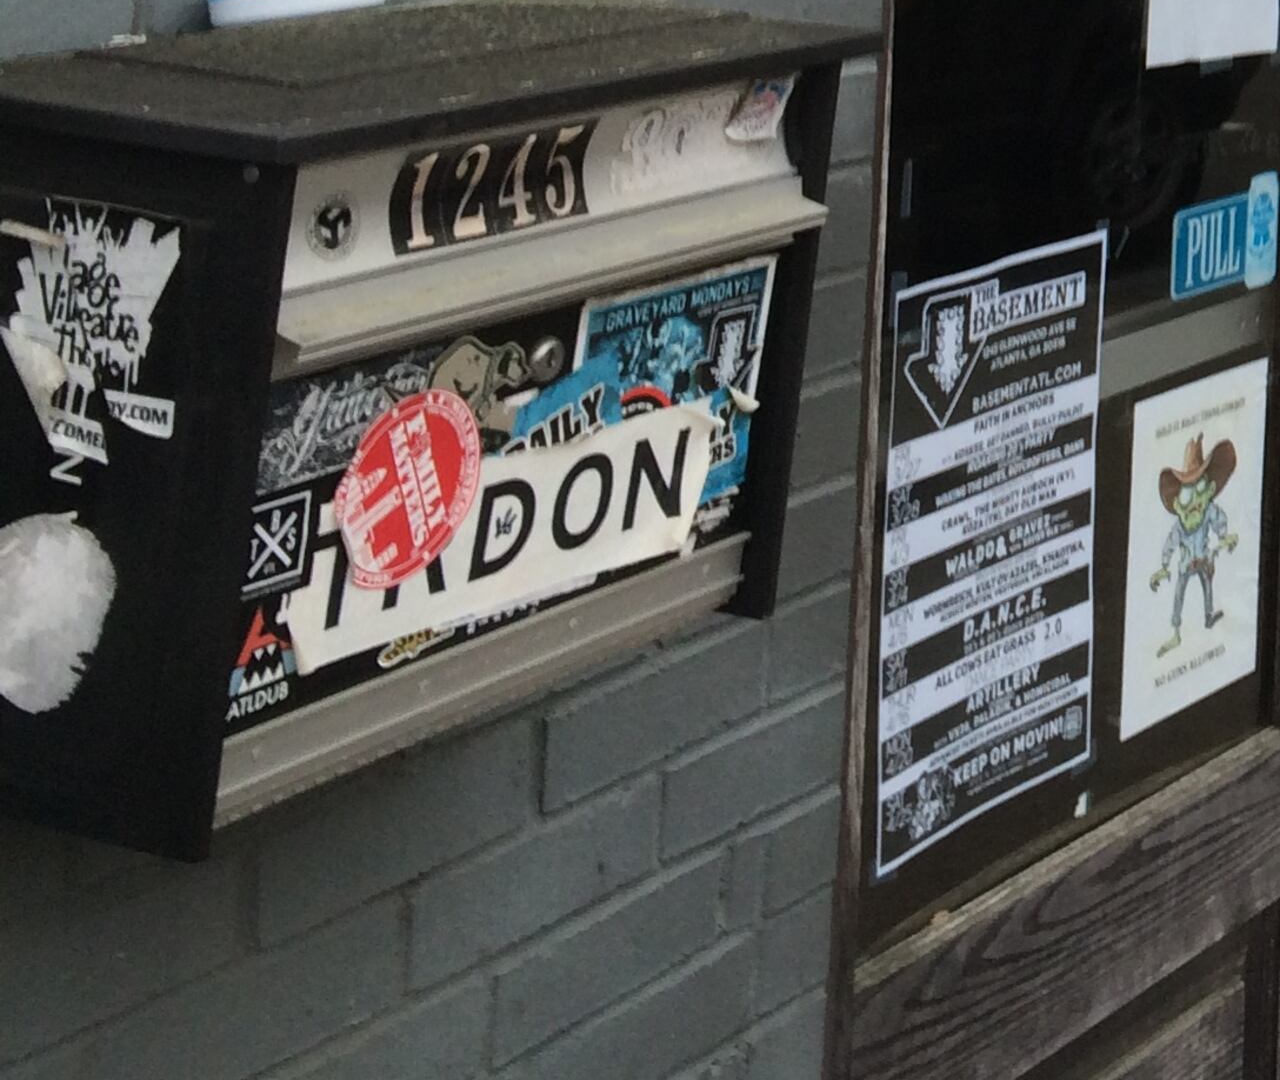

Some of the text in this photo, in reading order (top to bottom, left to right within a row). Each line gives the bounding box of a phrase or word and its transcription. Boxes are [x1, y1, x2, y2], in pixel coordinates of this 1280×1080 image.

[406, 125, 584, 250] 1245
[1185, 206, 1240, 289] PULL
[606, 293, 687, 333] GRAVEYARD
[690, 276, 750, 310] MONDAYS
[973, 276, 1083, 337] BASEMENT
[974, 285, 997, 304] THE
[972, 361, 1082, 413] BASEMENTATL.COM
[388, 421, 430, 548] MATTERS
[945, 542, 994, 578] WALDO
[963, 586, 1047, 642] D.A.N.C.E.
[935, 672, 953, 690] ALL
[955, 657, 982, 681] COWS
[983, 649, 1001, 665] EAT
[1002, 630, 1036, 656] GRASS
[1044, 618, 1063, 641] 2.0
[224, 681, 289, 723] ATLDUB
[966, 662, 1041, 714] ARTILLERY
[952, 752, 988, 788] KEEP
[990, 741, 1011, 768] ON
